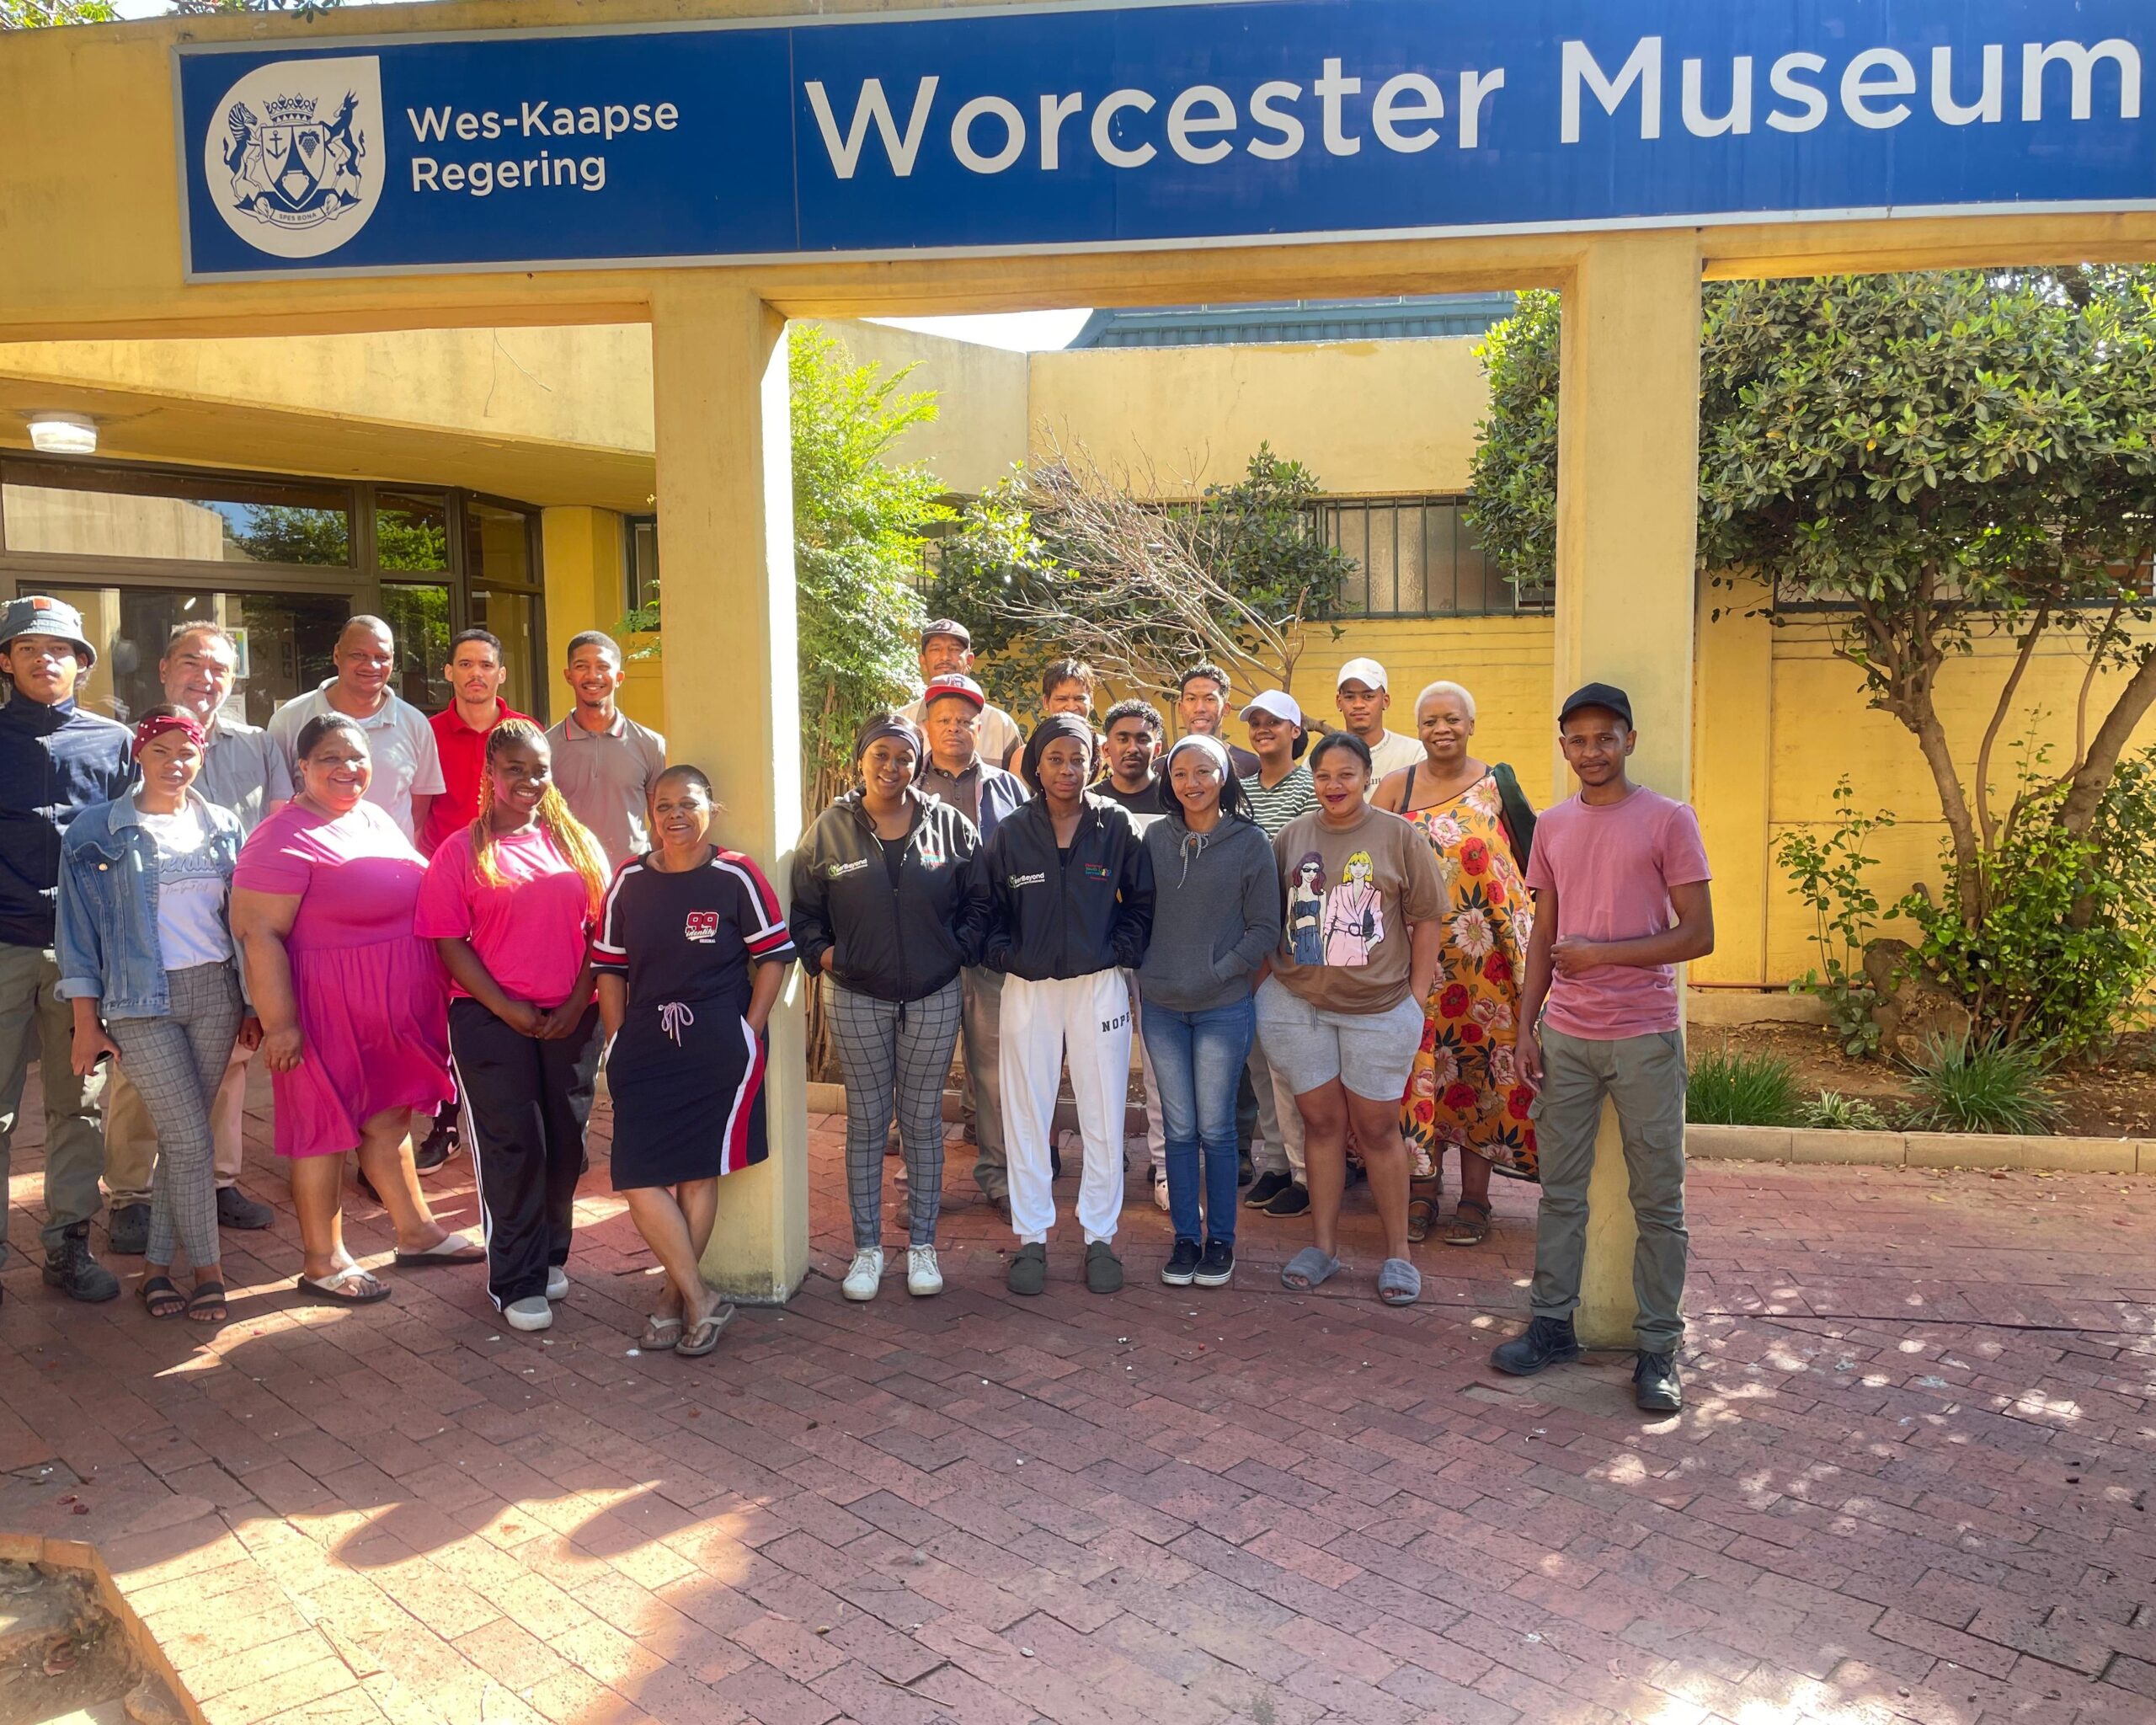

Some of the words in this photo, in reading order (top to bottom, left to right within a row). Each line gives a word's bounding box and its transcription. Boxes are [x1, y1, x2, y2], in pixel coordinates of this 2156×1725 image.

[407, 101, 679, 142] Wes-Kaapse
[803, 56, 1506, 179] Worcester
[1561, 36, 2141, 143] Museum
[412, 151, 606, 196] Regering
[297, 212, 316, 221] BONA
[685, 911, 719, 935] 99
